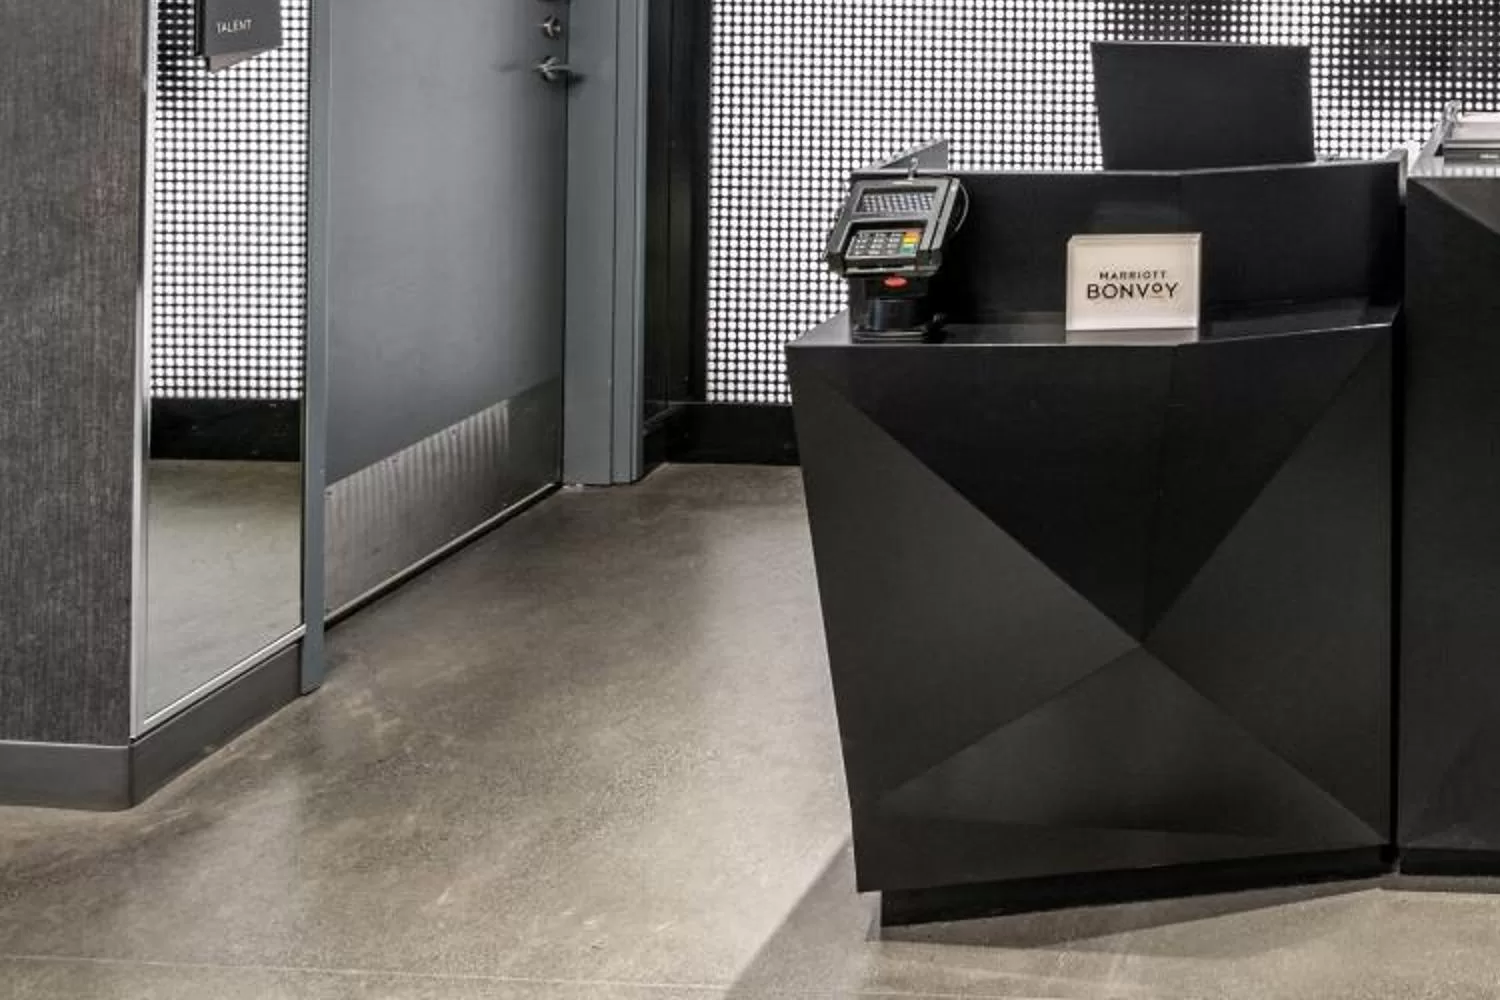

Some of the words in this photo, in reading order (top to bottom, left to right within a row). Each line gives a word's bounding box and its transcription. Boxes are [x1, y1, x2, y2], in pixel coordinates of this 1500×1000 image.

[216, 19, 253, 34] TALENT
[1099, 270, 1167, 280] MARRIOTT
[1087, 282, 1179, 299] BONVOY
